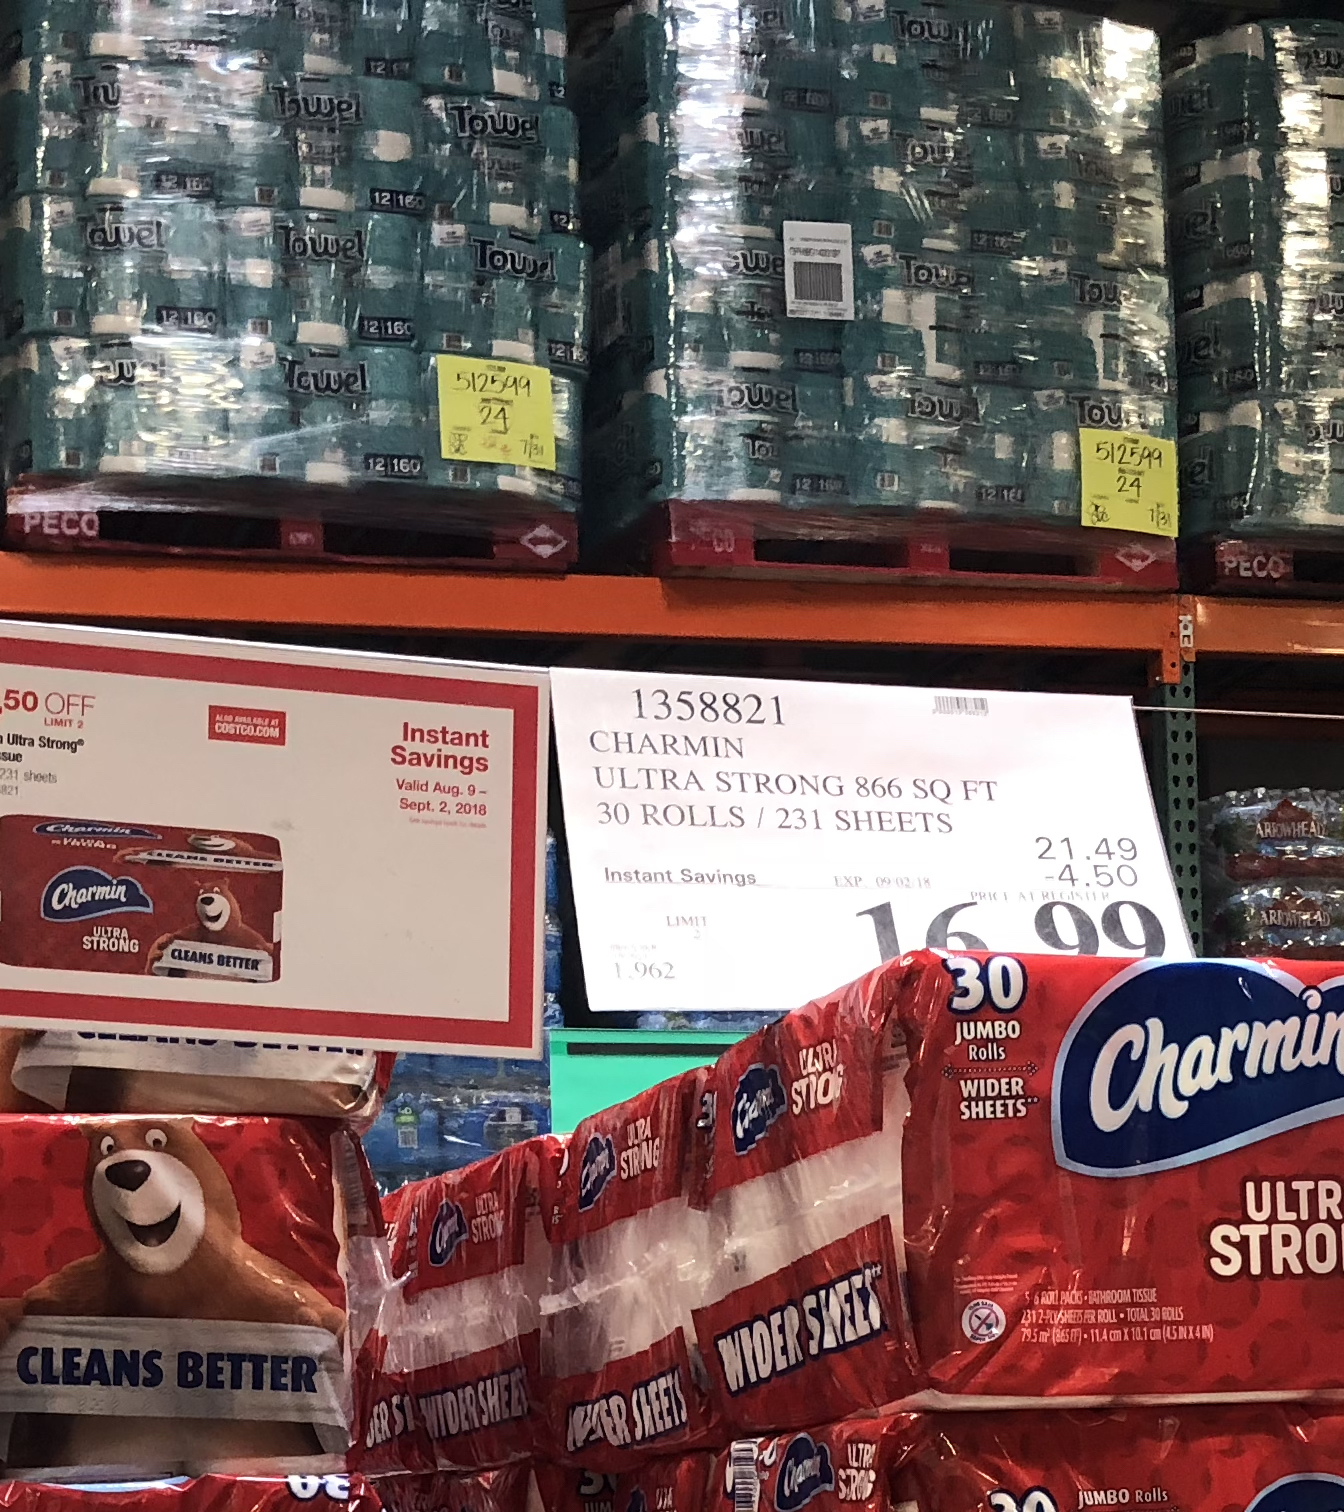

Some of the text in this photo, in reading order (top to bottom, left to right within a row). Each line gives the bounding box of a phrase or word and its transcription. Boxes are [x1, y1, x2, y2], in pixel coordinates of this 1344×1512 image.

[454, 104, 540, 143] Towel
[277, 223, 364, 262] Towel
[280, 357, 369, 396] Towel
[451, 372, 531, 397] 512599
[1096, 441, 1162, 469] 512599
[1116, 475, 1142, 498] 24
[23, 512, 100, 537] PECO
[1224, 557, 1284, 577] PECO
[44, 691, 96, 716] OFF
[630, 687, 786, 726] 1358821
[44, 717, 84, 729] LIMIT 2
[215, 722, 280, 738] COSTCO.COM
[403, 722, 489, 748] Instant
[6, 732, 35, 748] Ultra
[589, 730, 745, 760] CHARMIN
[391, 745, 489, 775] Savings
[396, 779, 476, 797] Valid Aug. 9
[592, 765, 998, 805] ULTRA STRONG 866 SQ FT
[399, 798, 487, 816] Sept. 2, 2018
[597, 802, 954, 835] 30 ROLLS 231 SHEETS
[1035, 836, 1138, 861] 21.49
[605, 867, 756, 888] Instant Savings
[1044, 863, 1138, 888] -4.50
[51, 879, 128, 911] Charmin
[82, 936, 139, 953] STRONG
[93, 926, 129, 939] ULTRA
[170, 948, 261, 972] CLEANS BETTER
[945, 957, 1025, 1012] 30
[954, 1018, 1021, 1047] JUMBO
[968, 1044, 1006, 1061] Rolls
[960, 1078, 1024, 1099] WIDER
[16, 1346, 318, 1394] CLEANS BETTER
[1077, 1486, 1131, 1507] JUMBO
[1134, 1486, 1167, 1504] Rolls
